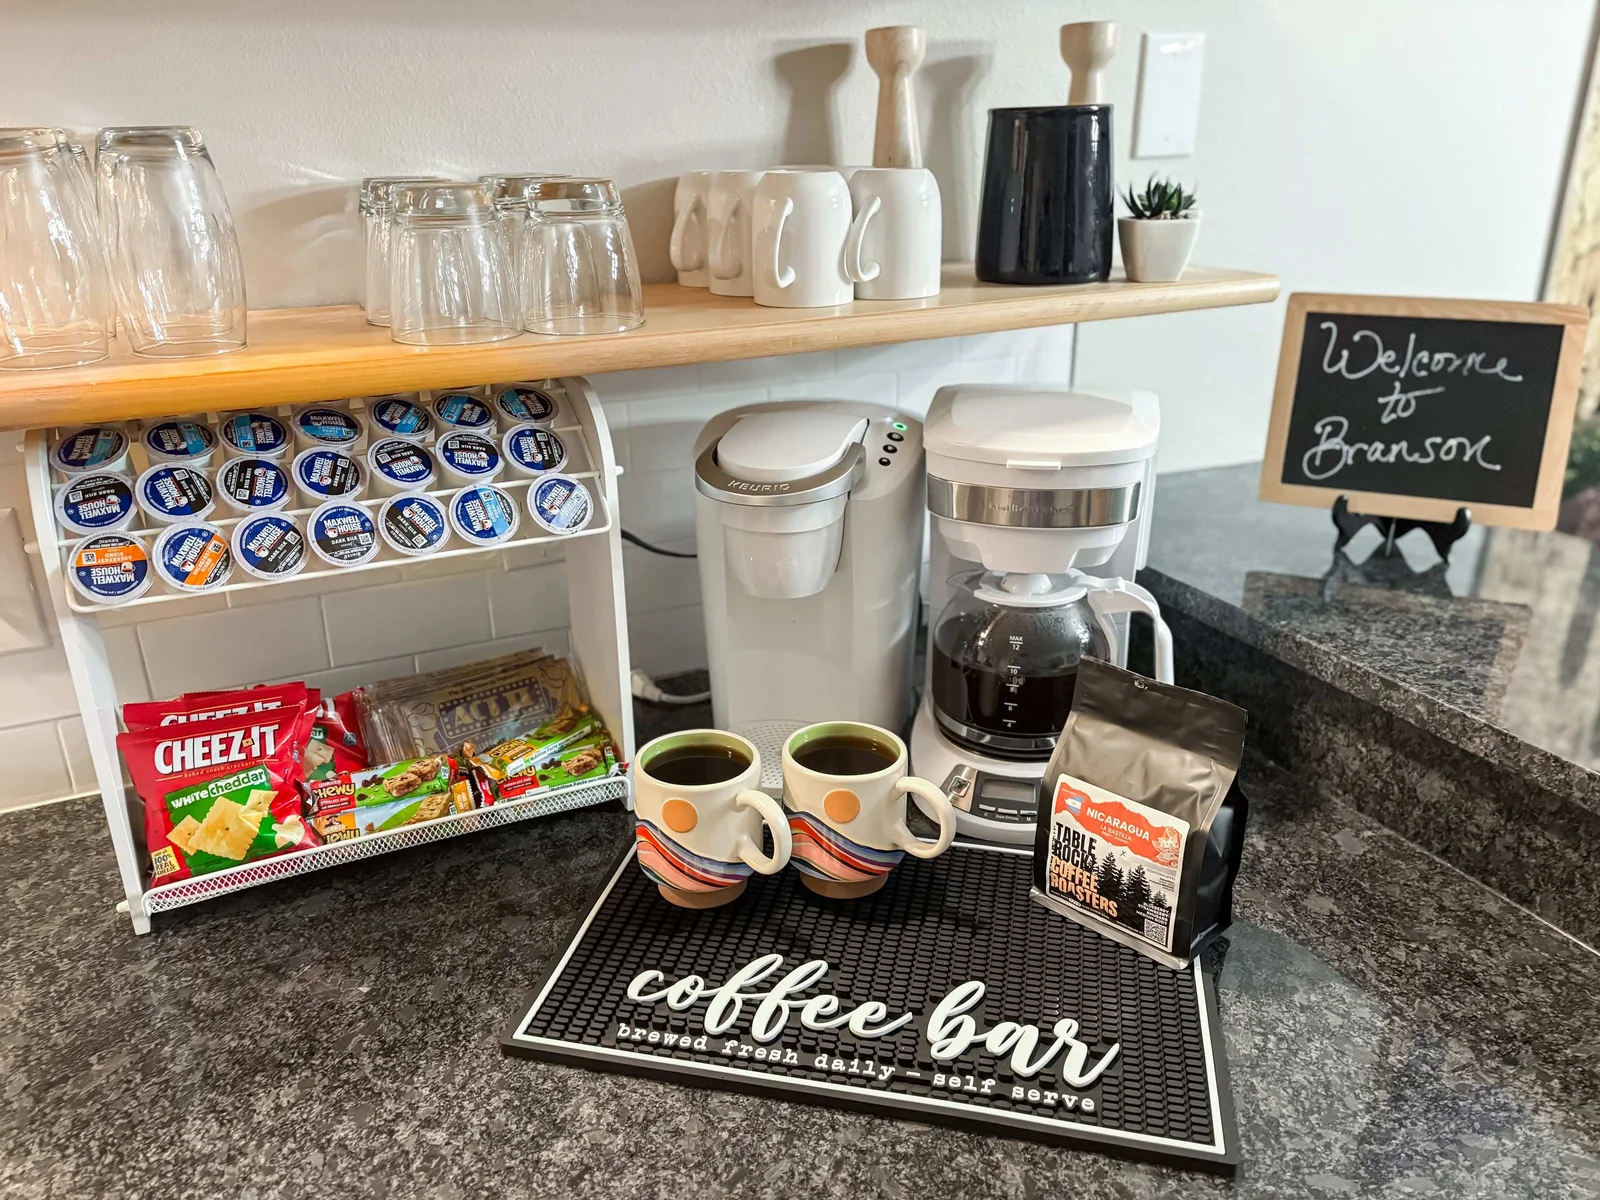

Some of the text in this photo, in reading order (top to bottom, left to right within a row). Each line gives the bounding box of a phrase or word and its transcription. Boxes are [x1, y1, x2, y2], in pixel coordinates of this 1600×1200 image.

[1320, 321, 1524, 380] Welcome
[1377, 381, 1445, 424] to
[309, 415, 346, 424] MAXWELL
[454, 451, 478, 460] HOUSE
[519, 436, 532, 463] MAXWELL
[1302, 416, 1502, 480] Branson
[309, 456, 325, 484] MAXWELL
[390, 460, 413, 470] HOUSE
[394, 463, 426, 476] MAXWELL
[455, 457, 488, 468] MAXWELL
[162, 476, 180, 498] HOUSE
[263, 469, 277, 498] MAXWELL
[727, 480, 790, 492] KEURIG
[78, 498, 106, 513] HOUSE
[153, 480, 177, 510] MAXWELL
[540, 484, 564, 510] MAXWELL
[80, 504, 121, 520] MAXWELL
[410, 502, 439, 530] MAXWELL
[464, 500, 483, 532] MAXWELL
[470, 498, 487, 520] HOUSE
[323, 515, 360, 528] MAXWELL
[337, 522, 363, 533] HOUSE
[396, 515, 418, 536] DARK SILK
[412, 514, 434, 535] HOUSE
[246, 523, 275, 552] MAXWELL
[262, 526, 284, 548] HOUSE
[331, 537, 346, 545] DARK
[170, 534, 198, 567] MAXWELL
[186, 537, 206, 562] HOUSE
[268, 540, 288, 562] DARK SILK
[90, 567, 122, 577] HOUSE
[92, 572, 135, 585] MAXWELL
[210, 770, 264, 797] cheddar
[1086, 807, 1150, 841] NICARAGUA
[1108, 827, 1132, 841] BASTILLA
[1056, 822, 1098, 856] TABLE
[154, 853, 173, 864] 100%
[156, 860, 174, 871] REAL
[1054, 840, 1091, 870] ROCK
[156, 866, 176, 876] CHEESE
[1051, 856, 1098, 894] COFFEE
[1050, 872, 1118, 918] ROASTERS
[626, 953, 1120, 1088] coffee bar
[616, 1023, 708, 1051] brewed
[722, 1040, 799, 1065] fresh
[814, 1053, 896, 1080] daily
[932, 1072, 996, 1094] self
[1012, 1085, 1096, 1113] serve
